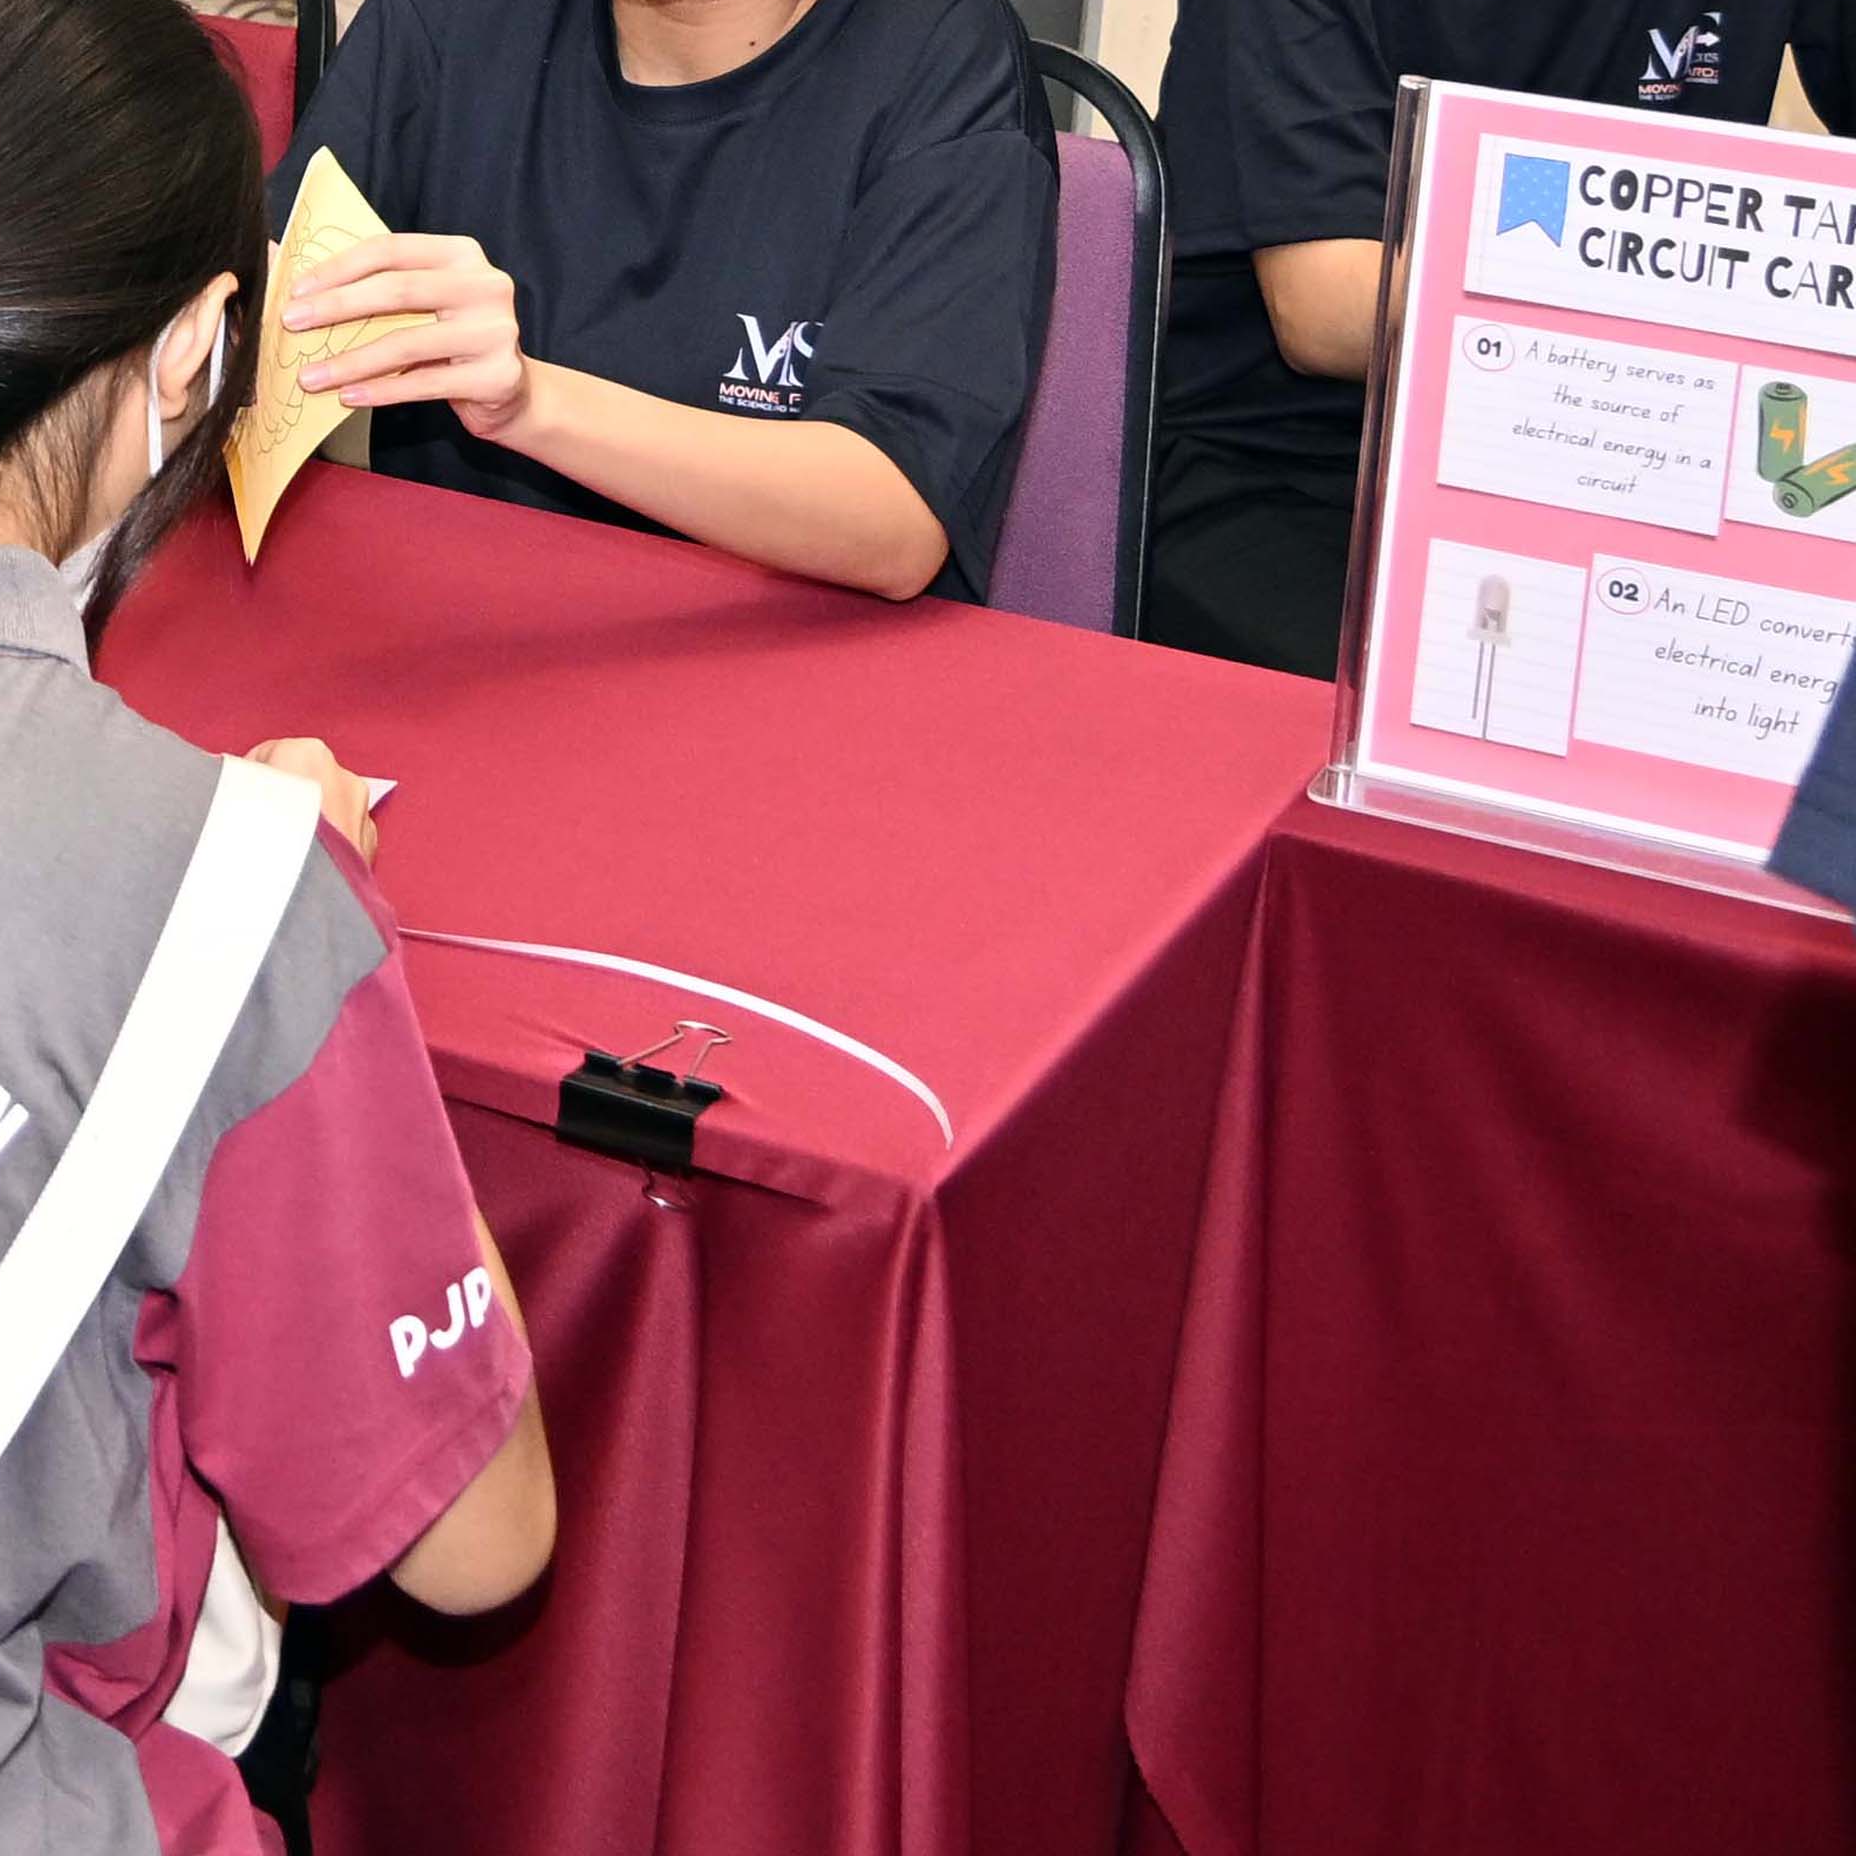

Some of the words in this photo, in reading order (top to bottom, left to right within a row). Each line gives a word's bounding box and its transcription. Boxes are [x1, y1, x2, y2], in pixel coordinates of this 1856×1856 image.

[1578, 165, 1765, 232] COPPER
[1578, 227, 1750, 289] CIRCUIT
[1764, 256, 1856, 309] CAR
[1476, 337, 1501, 357] 01
[1524, 340, 1538, 360] A
[1547, 343, 1618, 383] battery
[1626, 365, 1685, 386] serves
[1693, 375, 1715, 391] as
[1553, 383, 1583, 407] the
[1591, 397, 1651, 420] source
[1659, 404, 1685, 424] of
[1512, 417, 1598, 448] electrical
[1603, 439, 1668, 470] energy
[1675, 448, 1691, 465] in
[1699, 457, 1712, 470] a
[1577, 473, 1638, 494] circuit
[1608, 580, 1639, 602] 02
[1653, 587, 1686, 614] An
[1695, 594, 1751, 626] LED
[1655, 637, 1763, 678] electrical
[1770, 669, 1839, 705] energ
[1694, 696, 1738, 722] into
[1747, 702, 1800, 740] light
